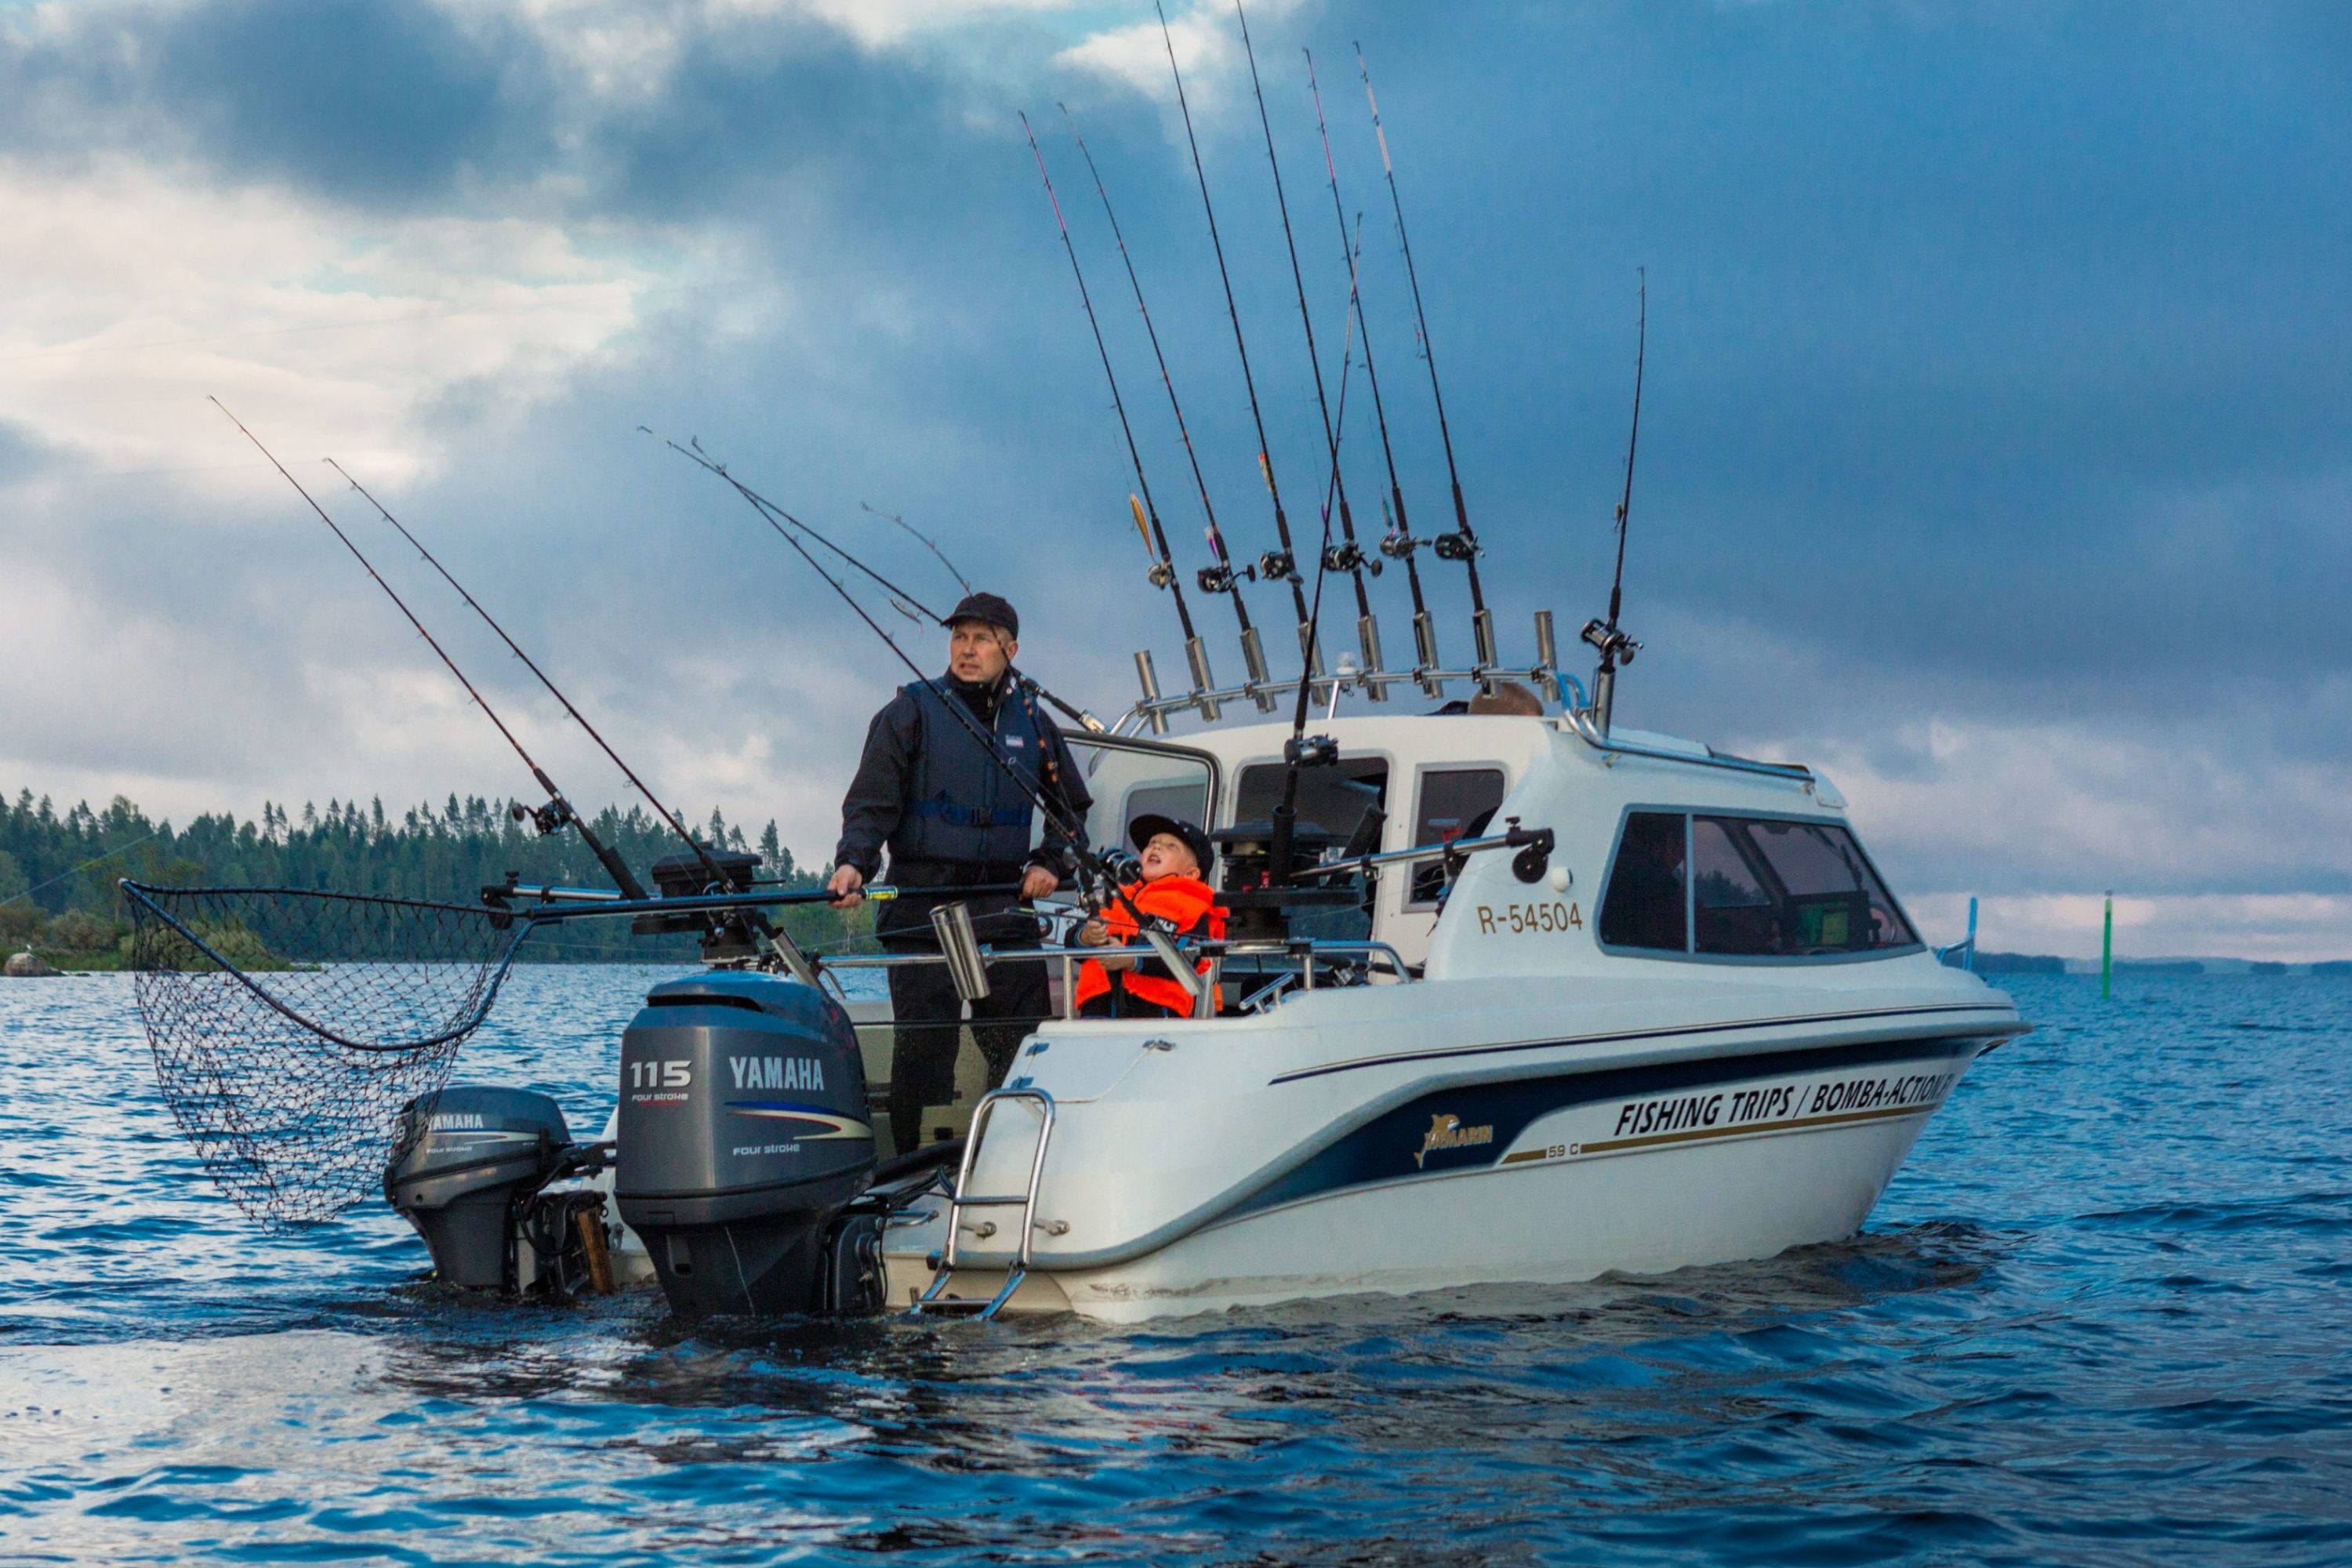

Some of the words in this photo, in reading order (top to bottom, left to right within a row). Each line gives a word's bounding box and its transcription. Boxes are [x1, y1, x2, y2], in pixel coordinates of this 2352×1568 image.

[1477, 902, 1582, 934] R-54504
[630, 1060, 691, 1088] 115
[729, 1056, 825, 1091] YAMAHA
[1613, 1094, 1724, 1136] FISHING
[1728, 1085, 1795, 1123] TRIPS
[1548, 1145, 1565, 1158] 59
[1570, 1142, 1579, 1156] C
